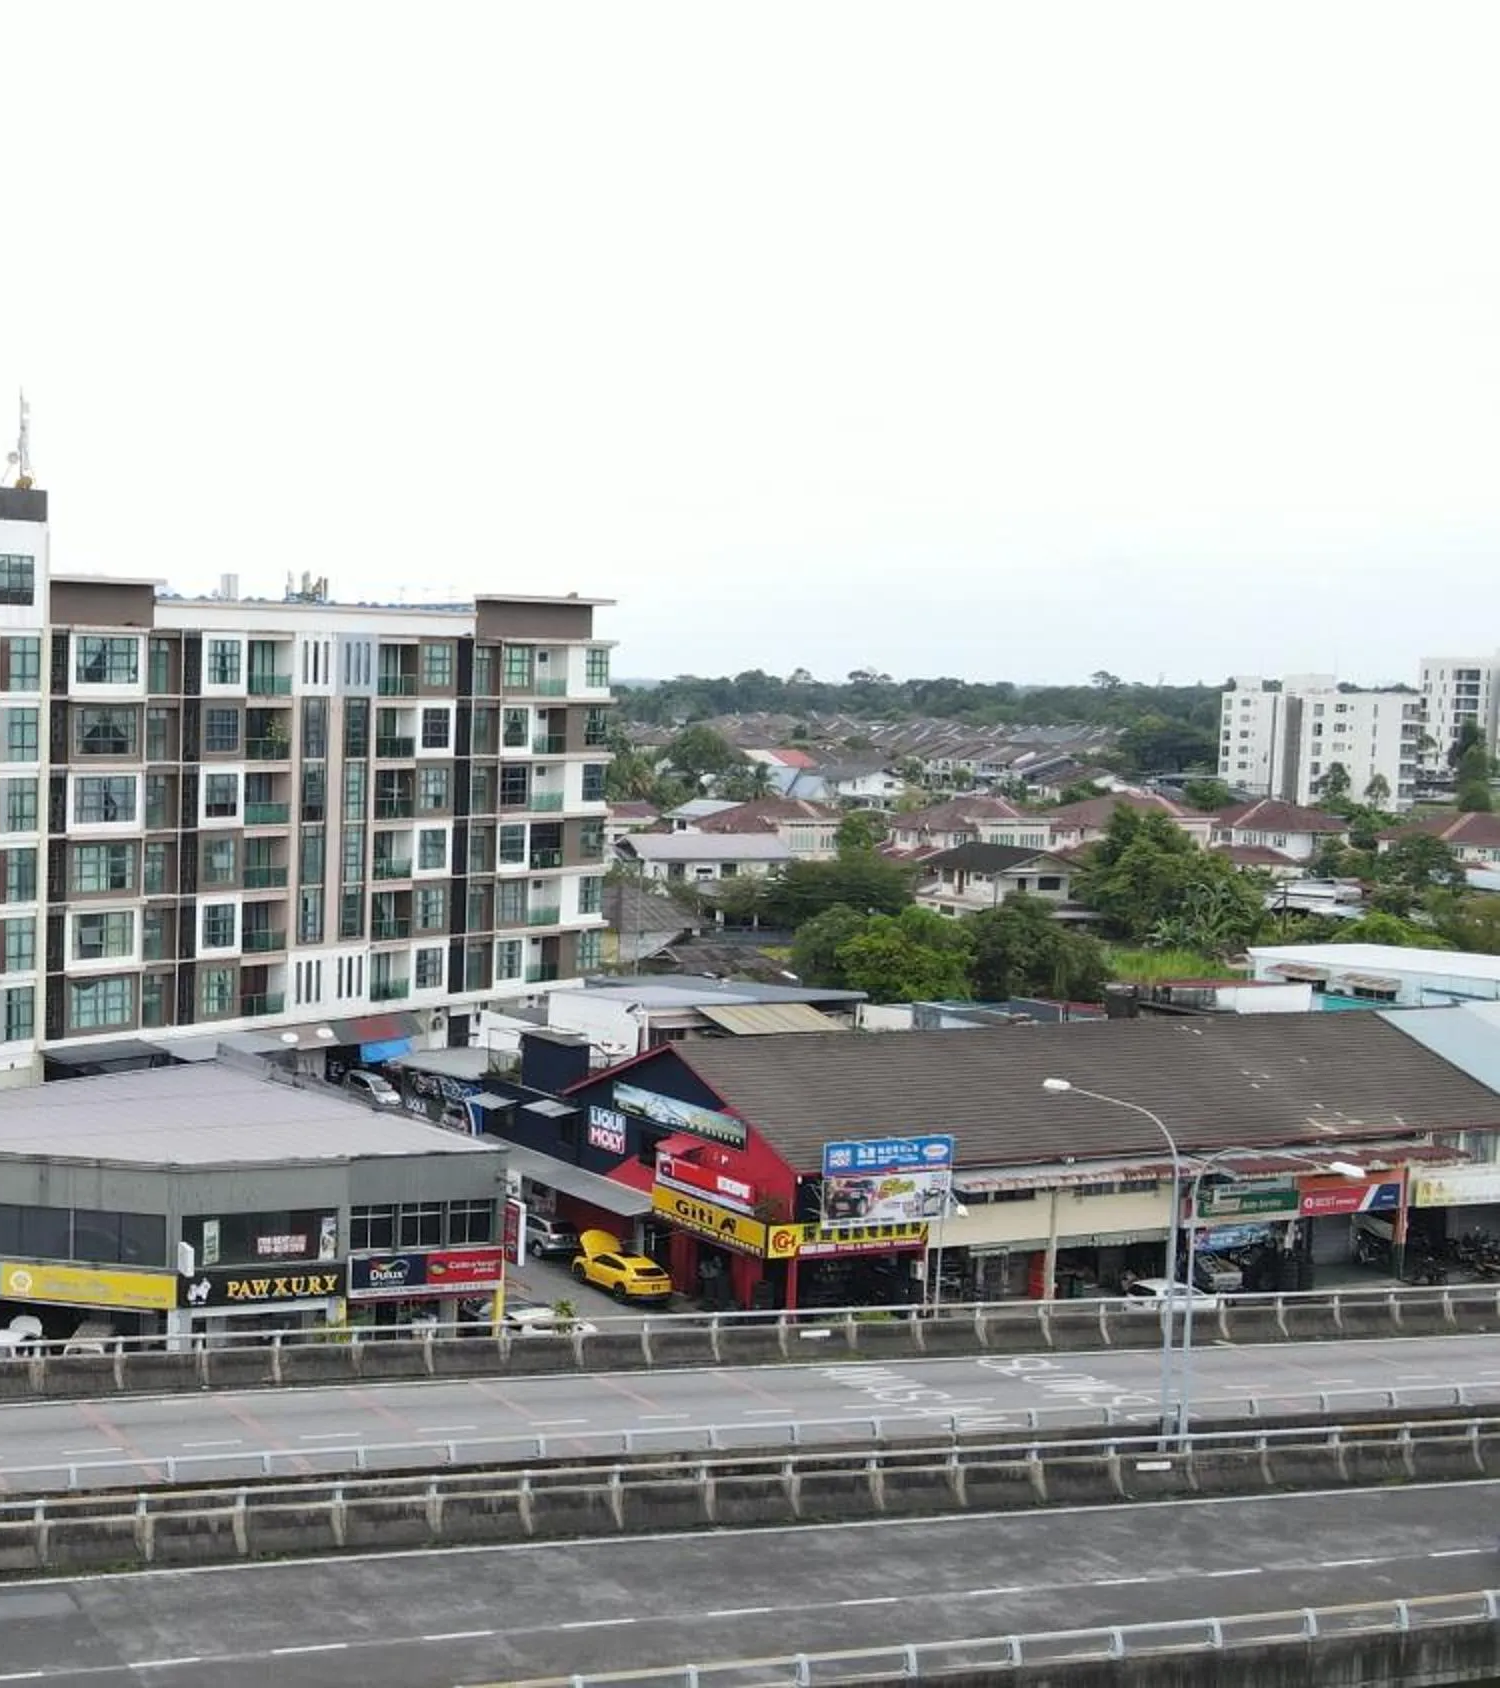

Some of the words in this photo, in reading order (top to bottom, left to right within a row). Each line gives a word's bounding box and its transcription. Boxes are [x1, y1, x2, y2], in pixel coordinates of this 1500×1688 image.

[589, 1105, 627, 1134] LIQUI
[588, 1126, 626, 1154] MOLY
[370, 1269, 404, 1281] Dulux
